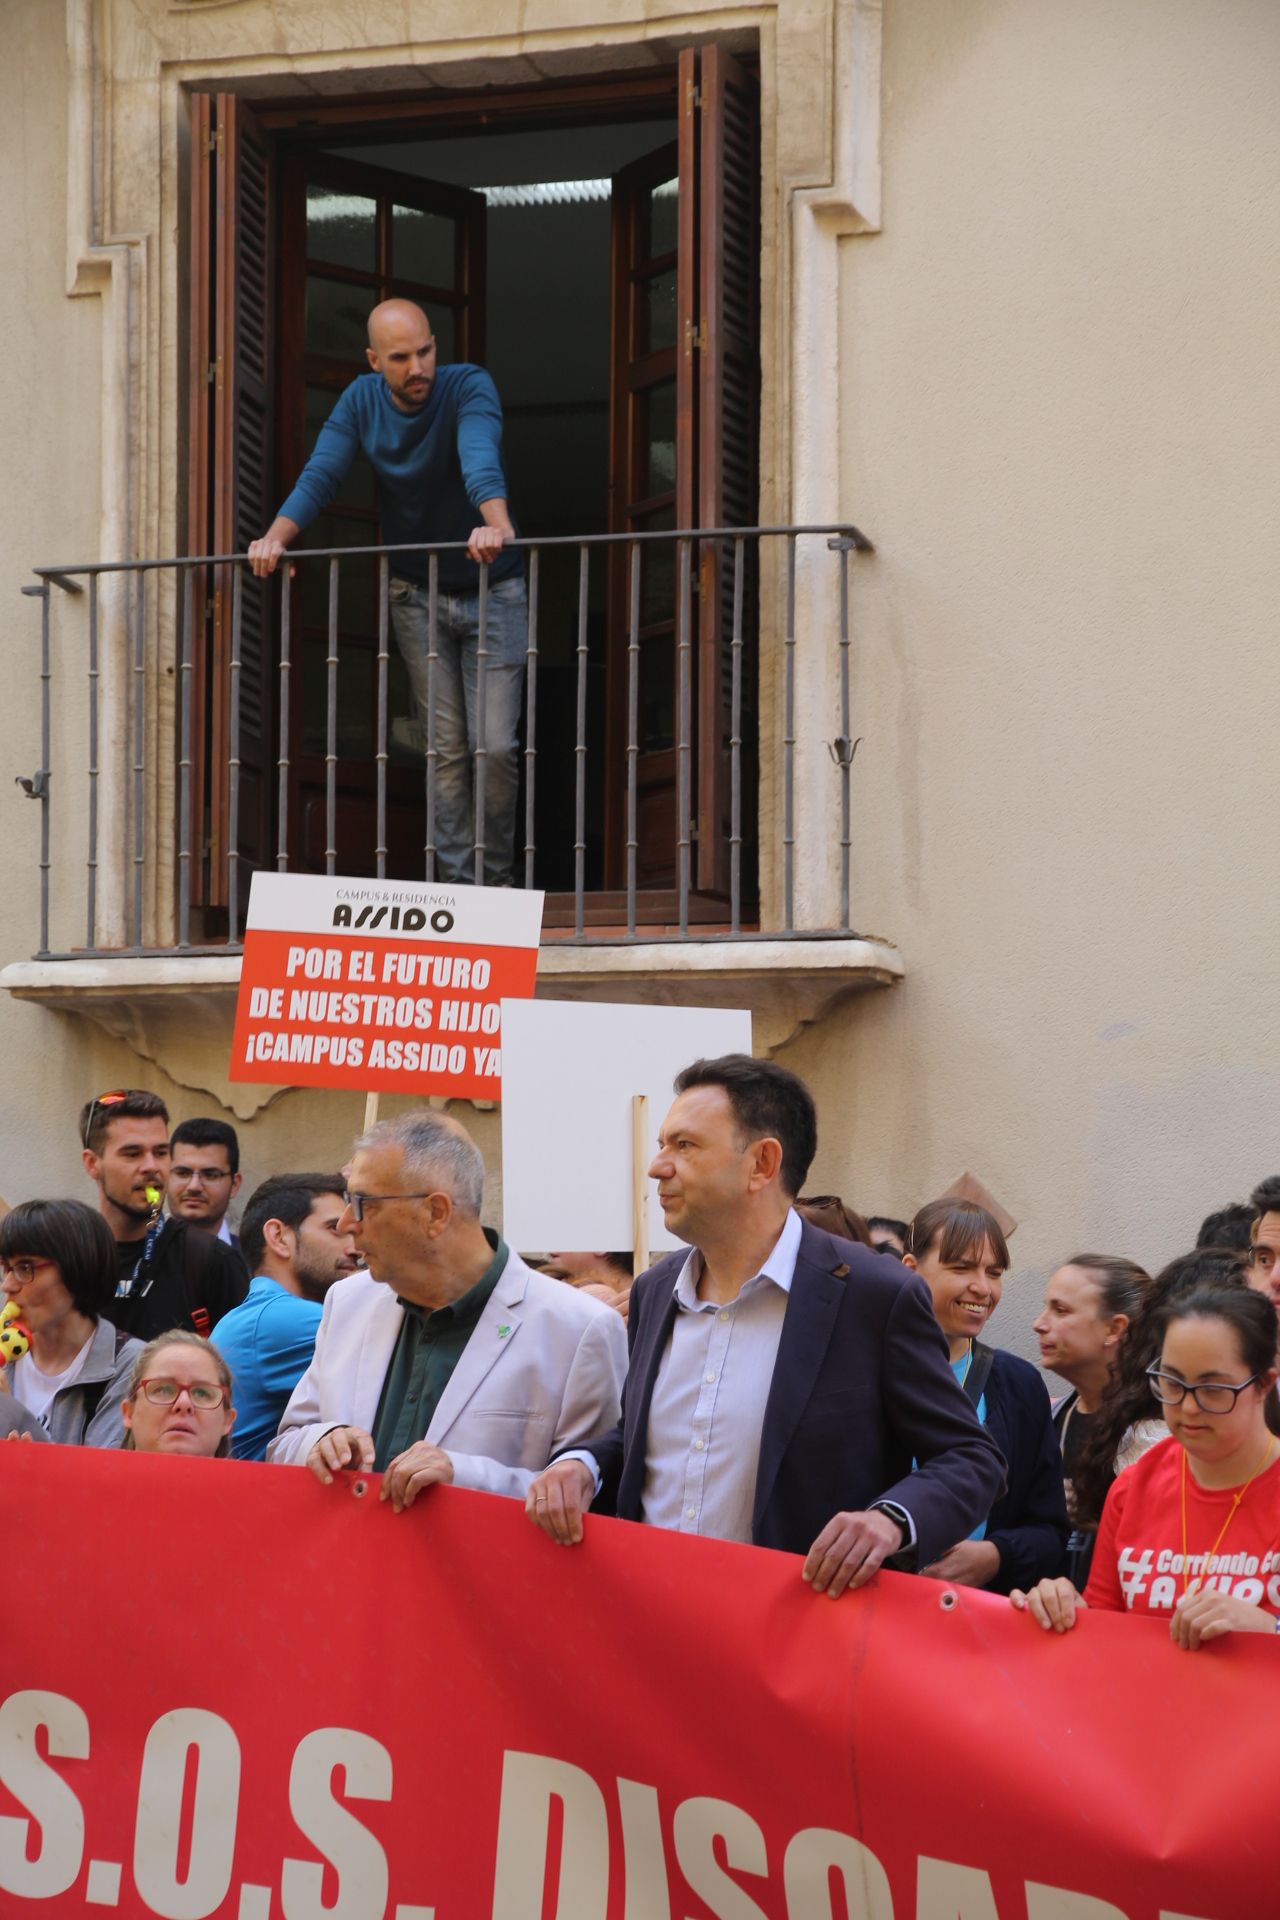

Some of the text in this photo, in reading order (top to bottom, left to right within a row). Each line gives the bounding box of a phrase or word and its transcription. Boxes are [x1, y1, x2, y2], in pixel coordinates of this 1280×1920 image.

[332, 904, 455, 933] ASSIDO
[336, 889, 456, 906] CAMPUS & RESIDENCIA
[286, 946, 491, 990] POR EL FUTURO
[249, 987, 285, 1019] DE
[288, 990, 433, 1029] NUESTROS
[245, 1031, 364, 1067] ¡CAMPUS
[368, 1039, 466, 1076] ASSIDO
